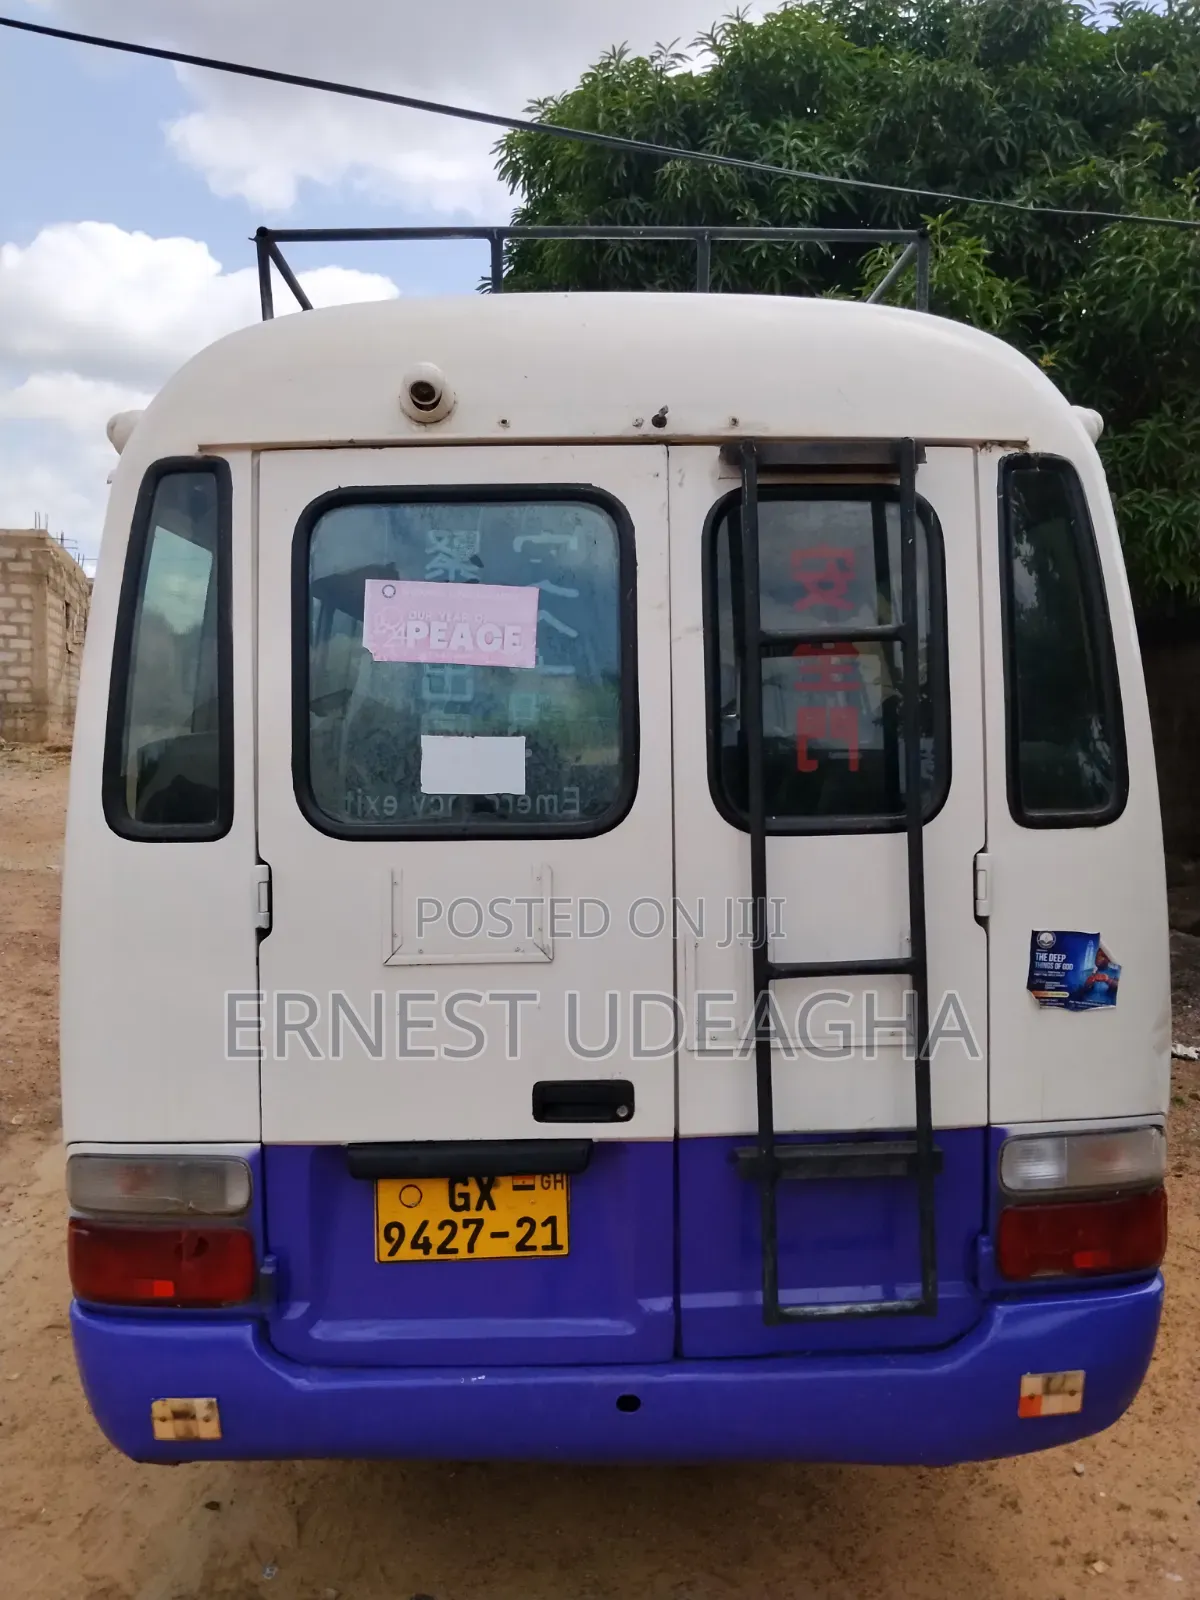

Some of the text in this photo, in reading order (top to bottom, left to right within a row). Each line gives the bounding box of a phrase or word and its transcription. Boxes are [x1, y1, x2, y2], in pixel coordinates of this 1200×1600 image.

[406, 619, 524, 654] PEACE
[1034, 961, 1074, 971] THINGS OF GOD
[1035, 952, 1067, 963] THE DEEP
[448, 1176, 496, 1213] GX
[540, 1174, 564, 1190] GH
[383, 1215, 564, 1257] 9427-21
